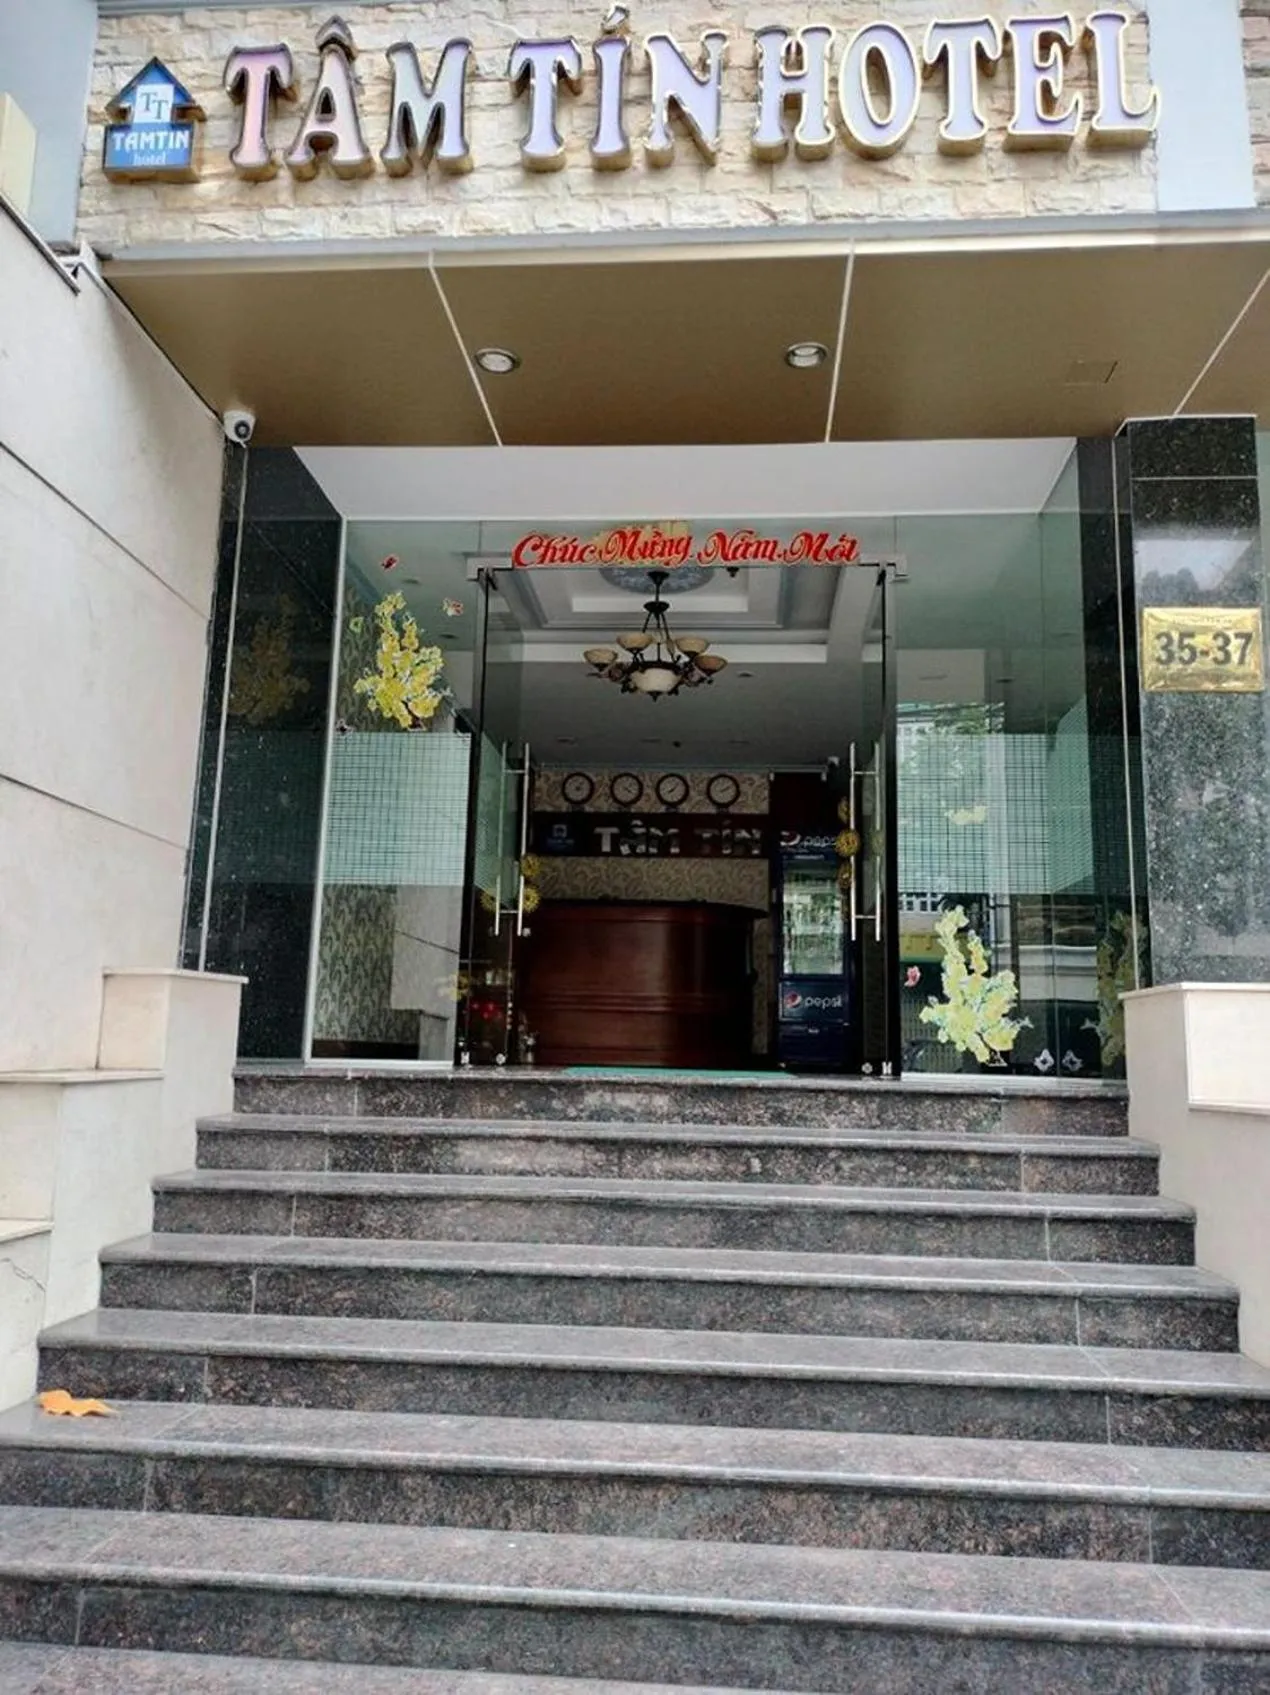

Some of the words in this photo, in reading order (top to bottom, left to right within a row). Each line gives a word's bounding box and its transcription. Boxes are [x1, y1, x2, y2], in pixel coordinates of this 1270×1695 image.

[224, 15, 476, 174] TÂM
[507, 3, 729, 168] TÍN
[749, 10, 1160, 158] HOTEL
[111, 129, 190, 153] TAMTIN
[511, 531, 599, 568] Chúc
[1155, 630, 1254, 667] 35-37
[803, 993, 844, 1010] pepsi
